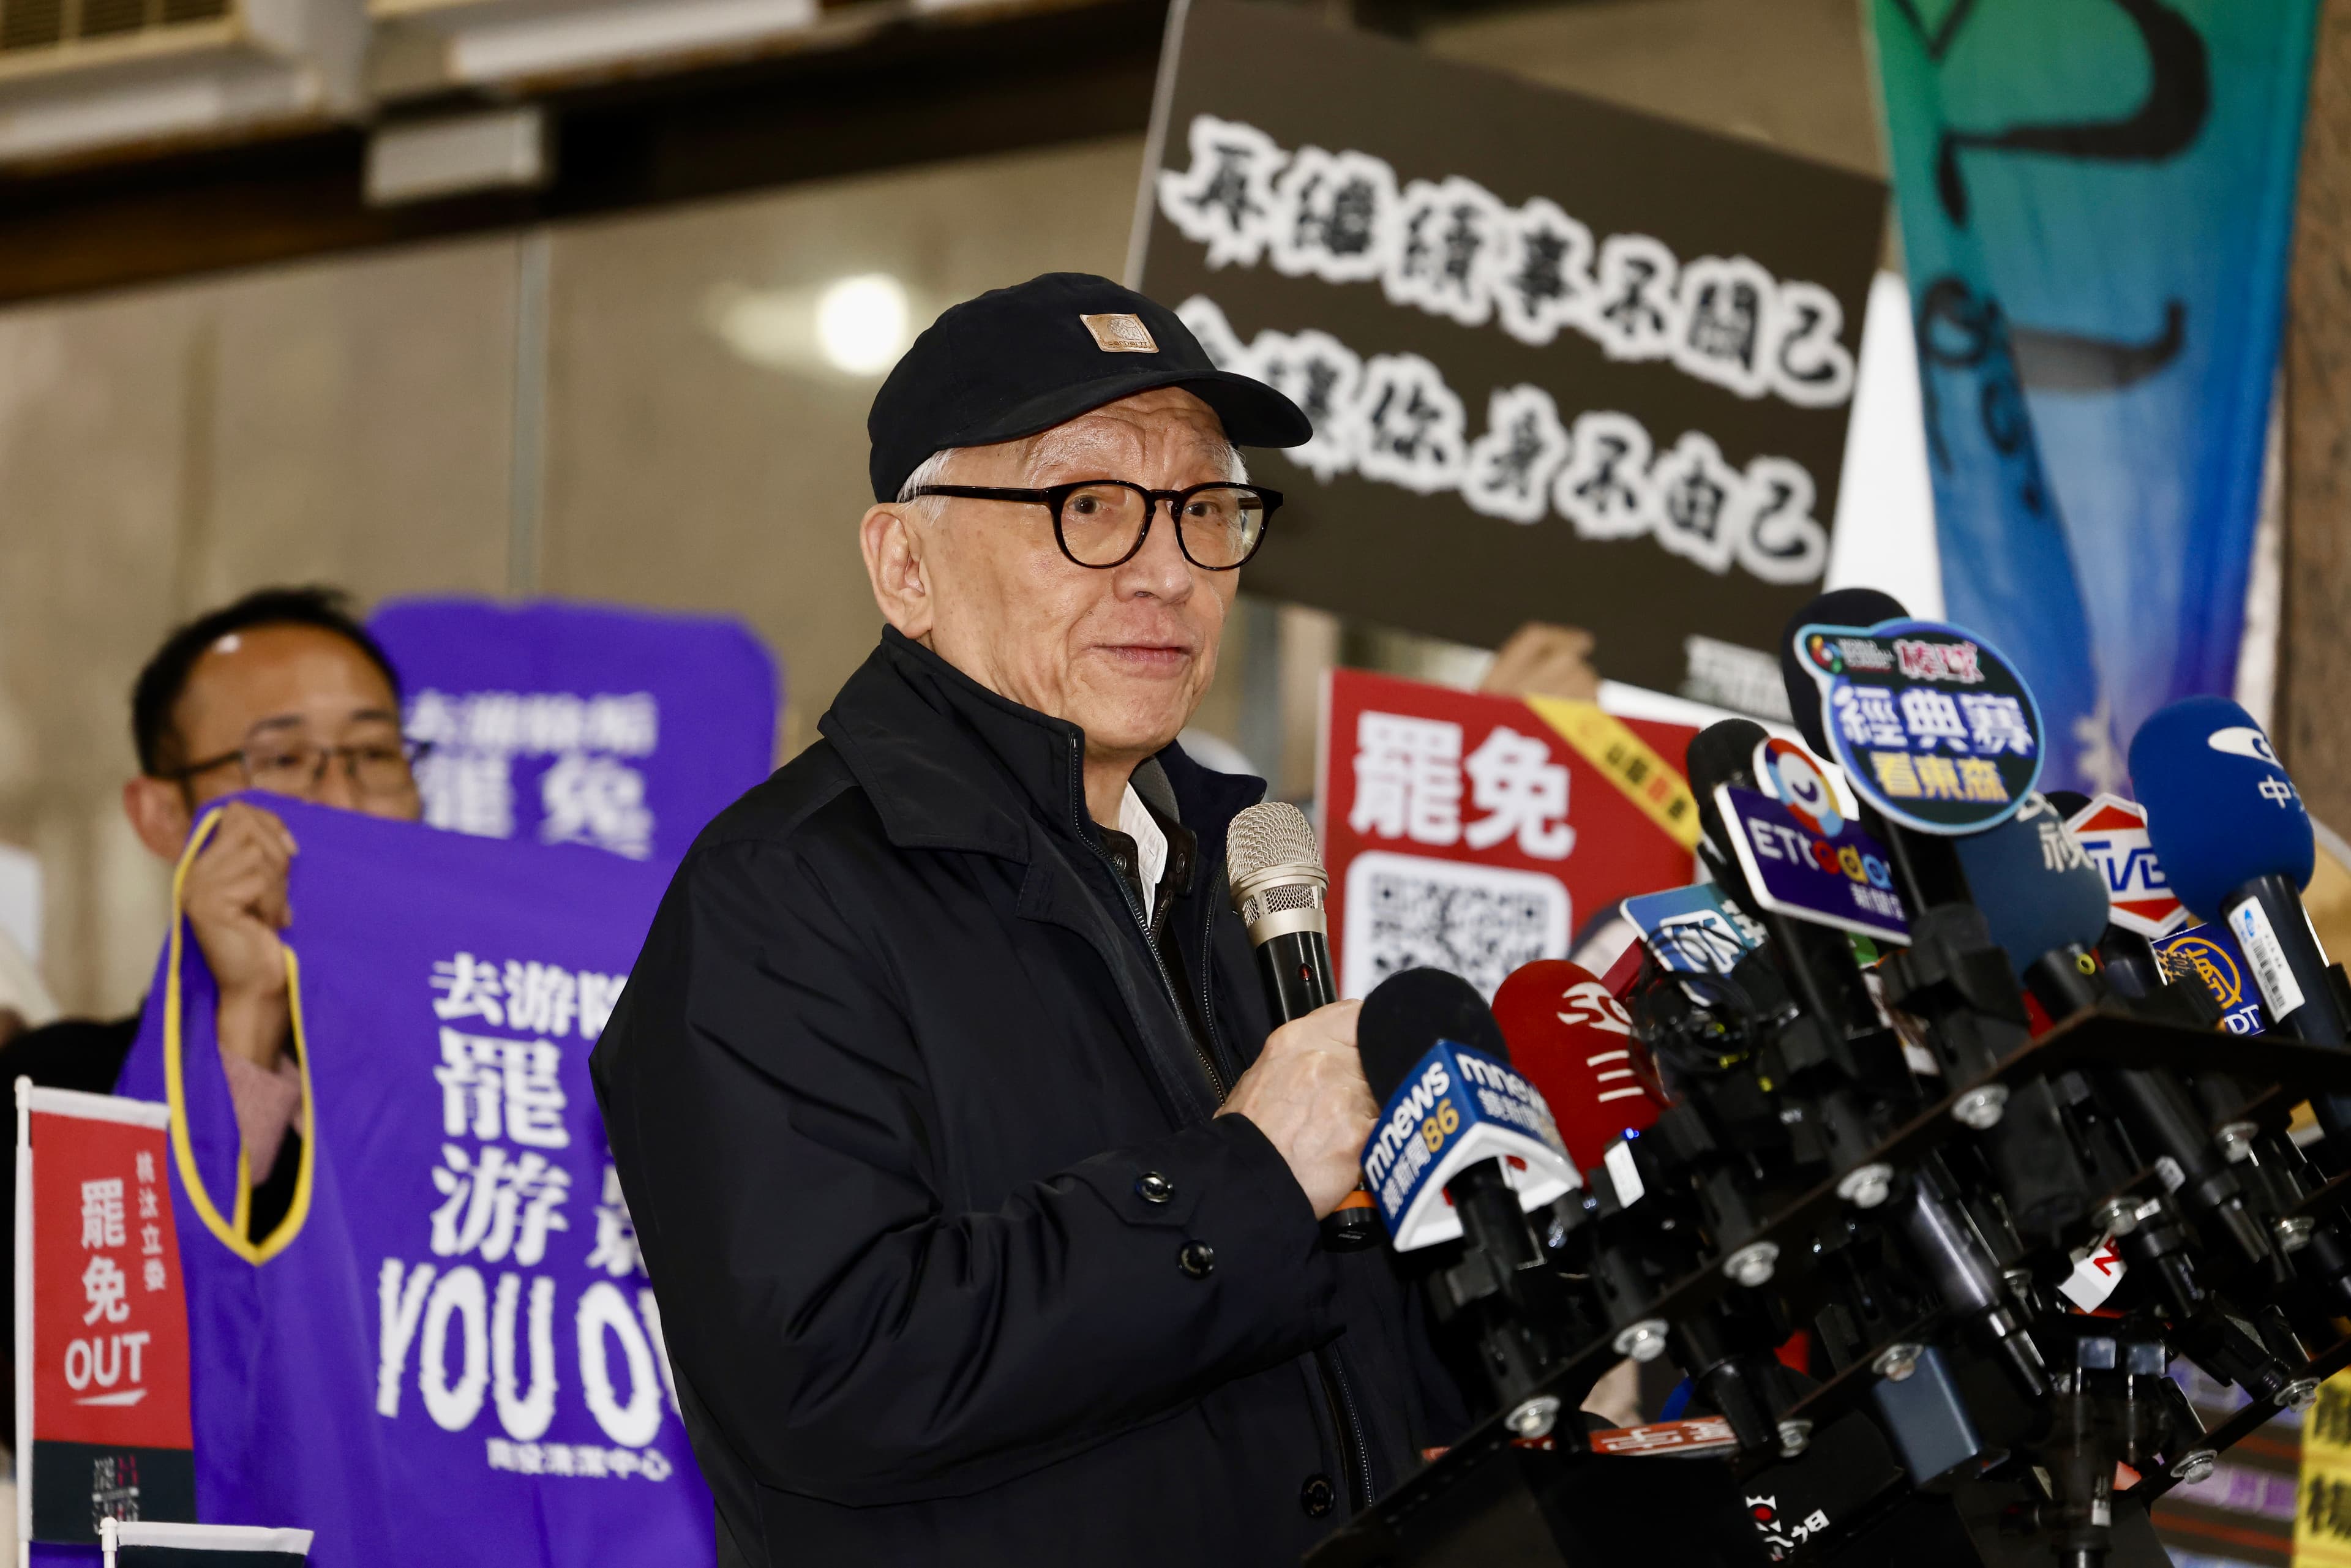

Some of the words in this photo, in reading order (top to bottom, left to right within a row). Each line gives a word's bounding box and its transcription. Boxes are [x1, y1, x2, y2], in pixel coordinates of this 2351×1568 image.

[1833, 686, 2034, 755] 經典賽
[1348, 710, 1576, 861] 罷免
[432, 1027, 570, 1149] 罷
[1365, 1062, 1450, 1191] mnews
[1421, 1098, 1459, 1153] 86
[80, 1178, 129, 1326] 罷免
[64, 1332, 151, 1390] OUT
[376, 1258, 558, 1441] YOU
